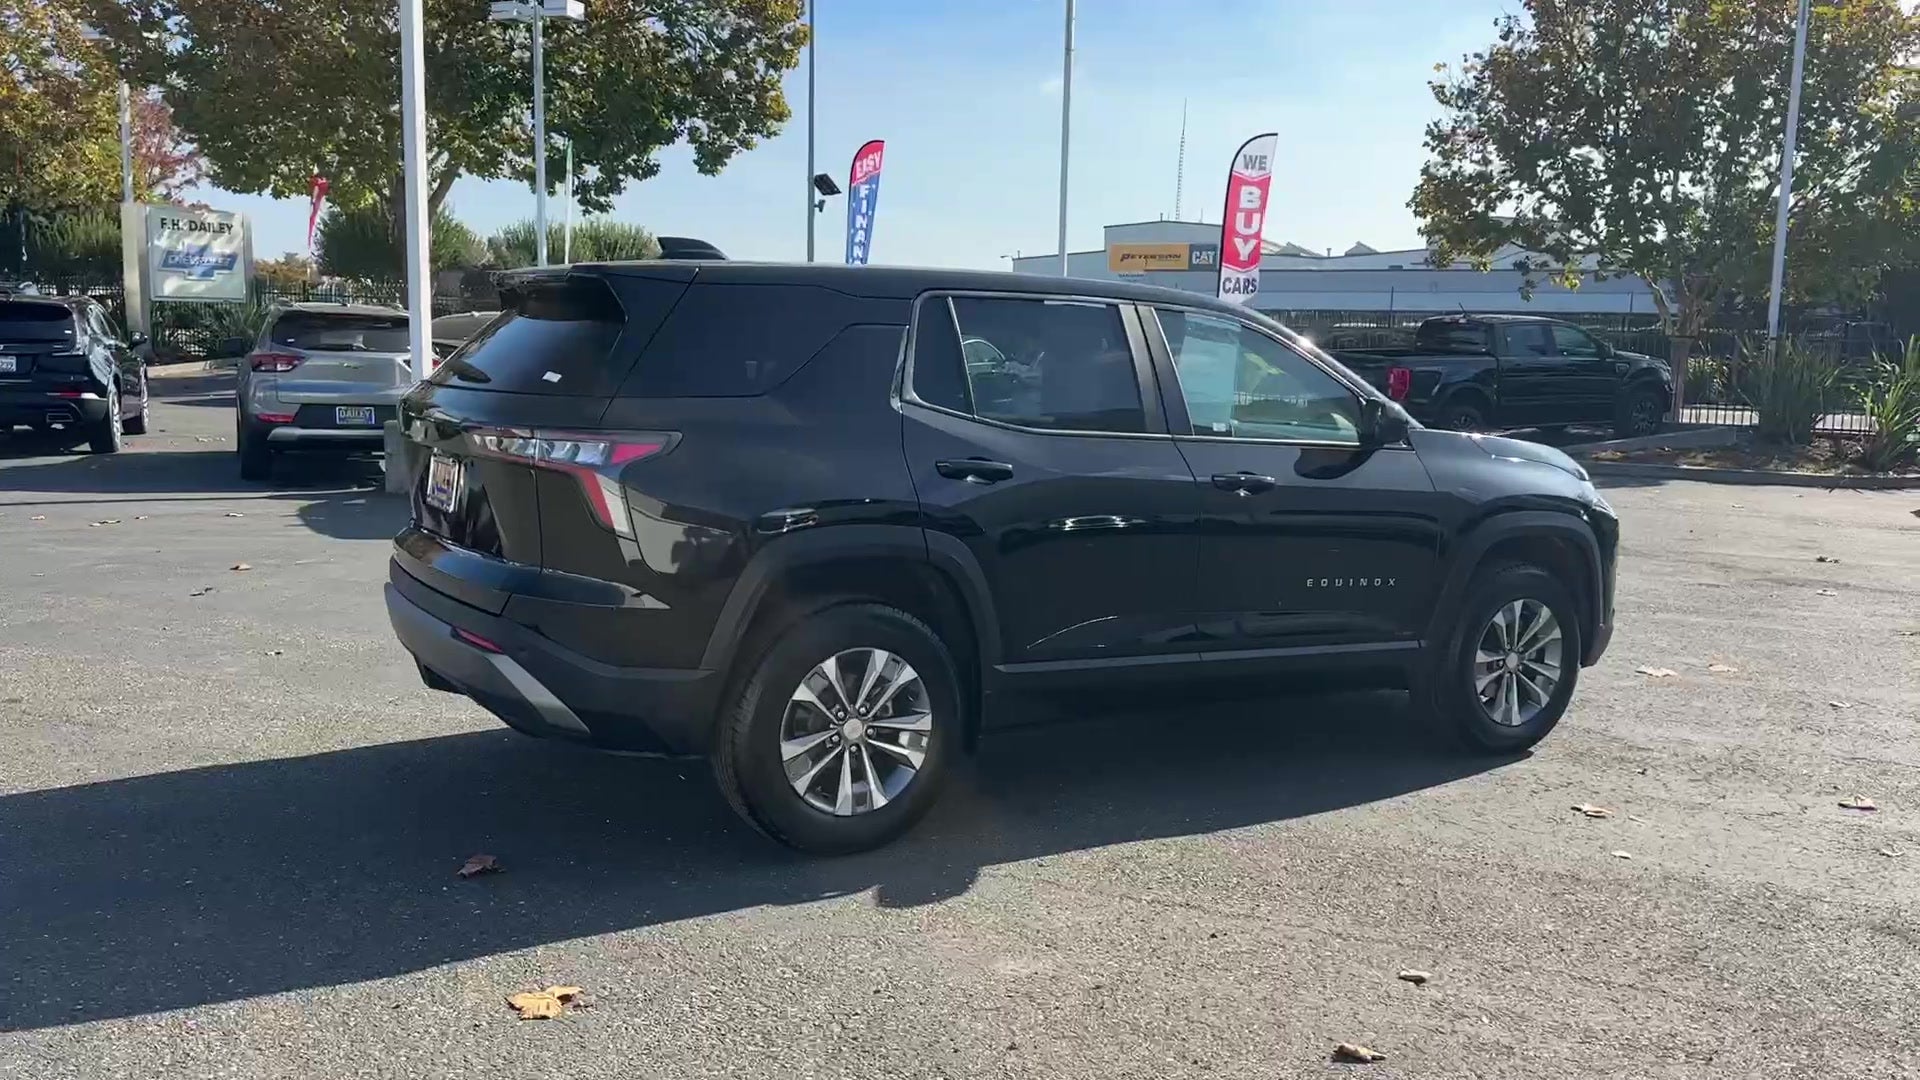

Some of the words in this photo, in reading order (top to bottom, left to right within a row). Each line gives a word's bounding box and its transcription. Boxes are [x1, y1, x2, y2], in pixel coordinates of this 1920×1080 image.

[855, 151, 881, 178] EASY
[1243, 154, 1267, 171] WE
[160, 217, 183, 230] F.H.
[188, 220, 233, 234] DAILEY
[1234, 185, 1261, 261] BUY
[1192, 251, 1215, 264] CAT
[1222, 277, 1257, 294] CARS
[1306, 578, 1396, 587] EQUINOX
